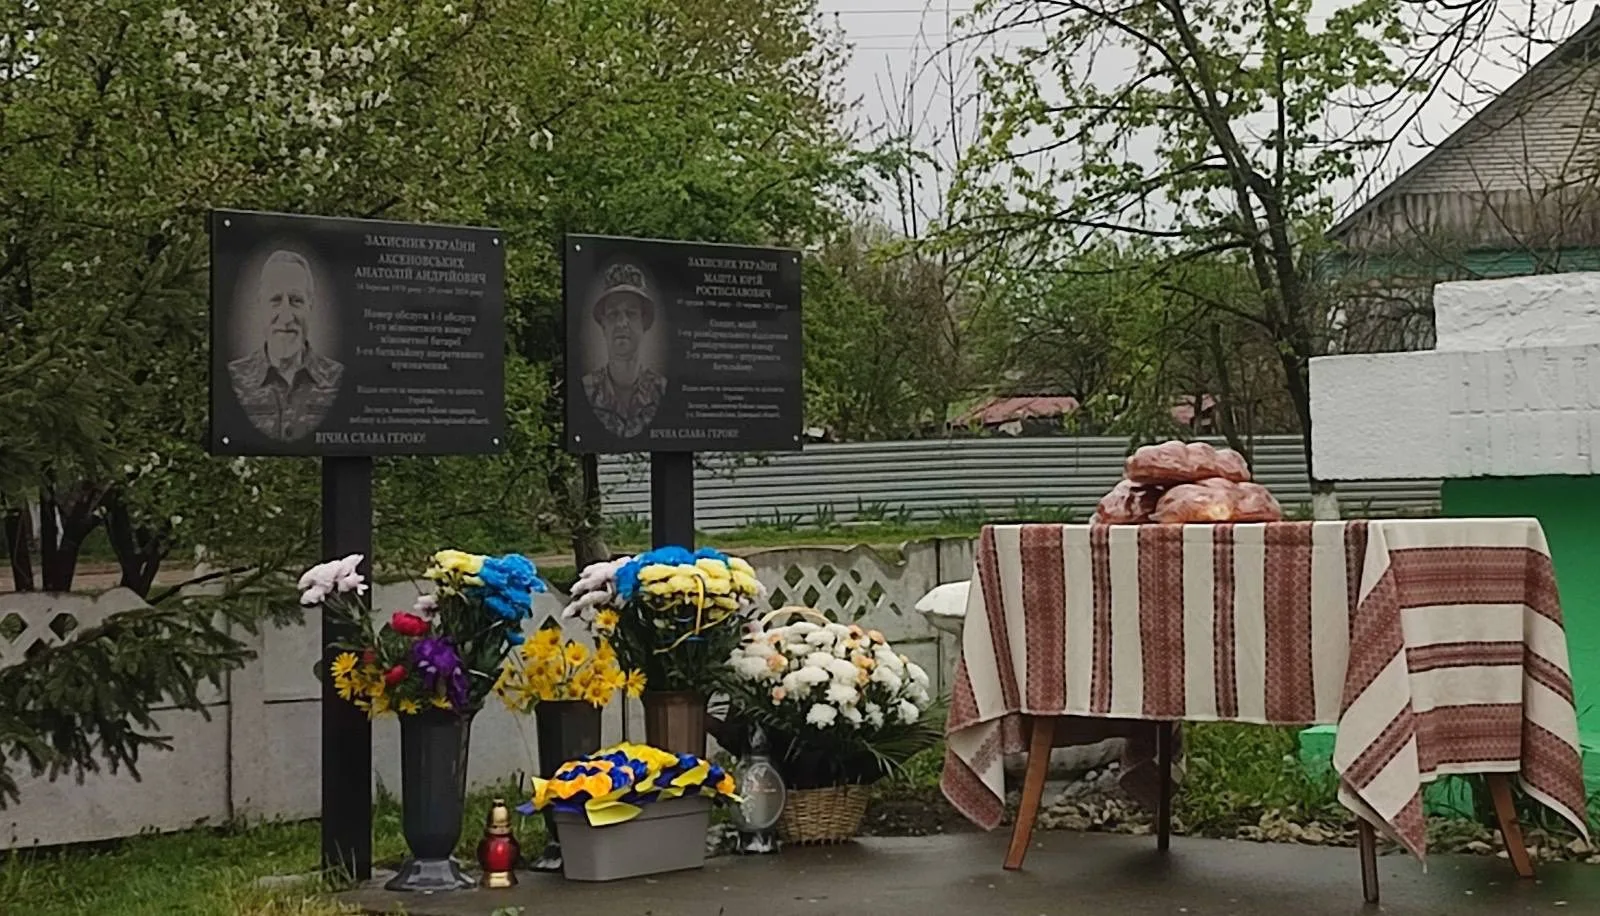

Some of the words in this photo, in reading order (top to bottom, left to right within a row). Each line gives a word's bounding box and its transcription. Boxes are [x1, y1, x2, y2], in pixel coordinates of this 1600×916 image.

[364, 234, 426, 249] ЗАХИСНИК
[428, 237, 476, 252] УКРАЇНИ
[687, 256, 737, 269] ЗАХИСНИК
[739, 259, 778, 272] УКРАЇНИ
[354, 266, 413, 280] АНАТОЛІЙ
[416, 269, 486, 284] АНДРІЙОВИЧ
[315, 432, 350, 444] ВІЧНА
[351, 432, 386, 444] СЛАВА
[649, 428, 677, 439] ВІЧНА
[678, 428, 706, 439] СЛАВА
